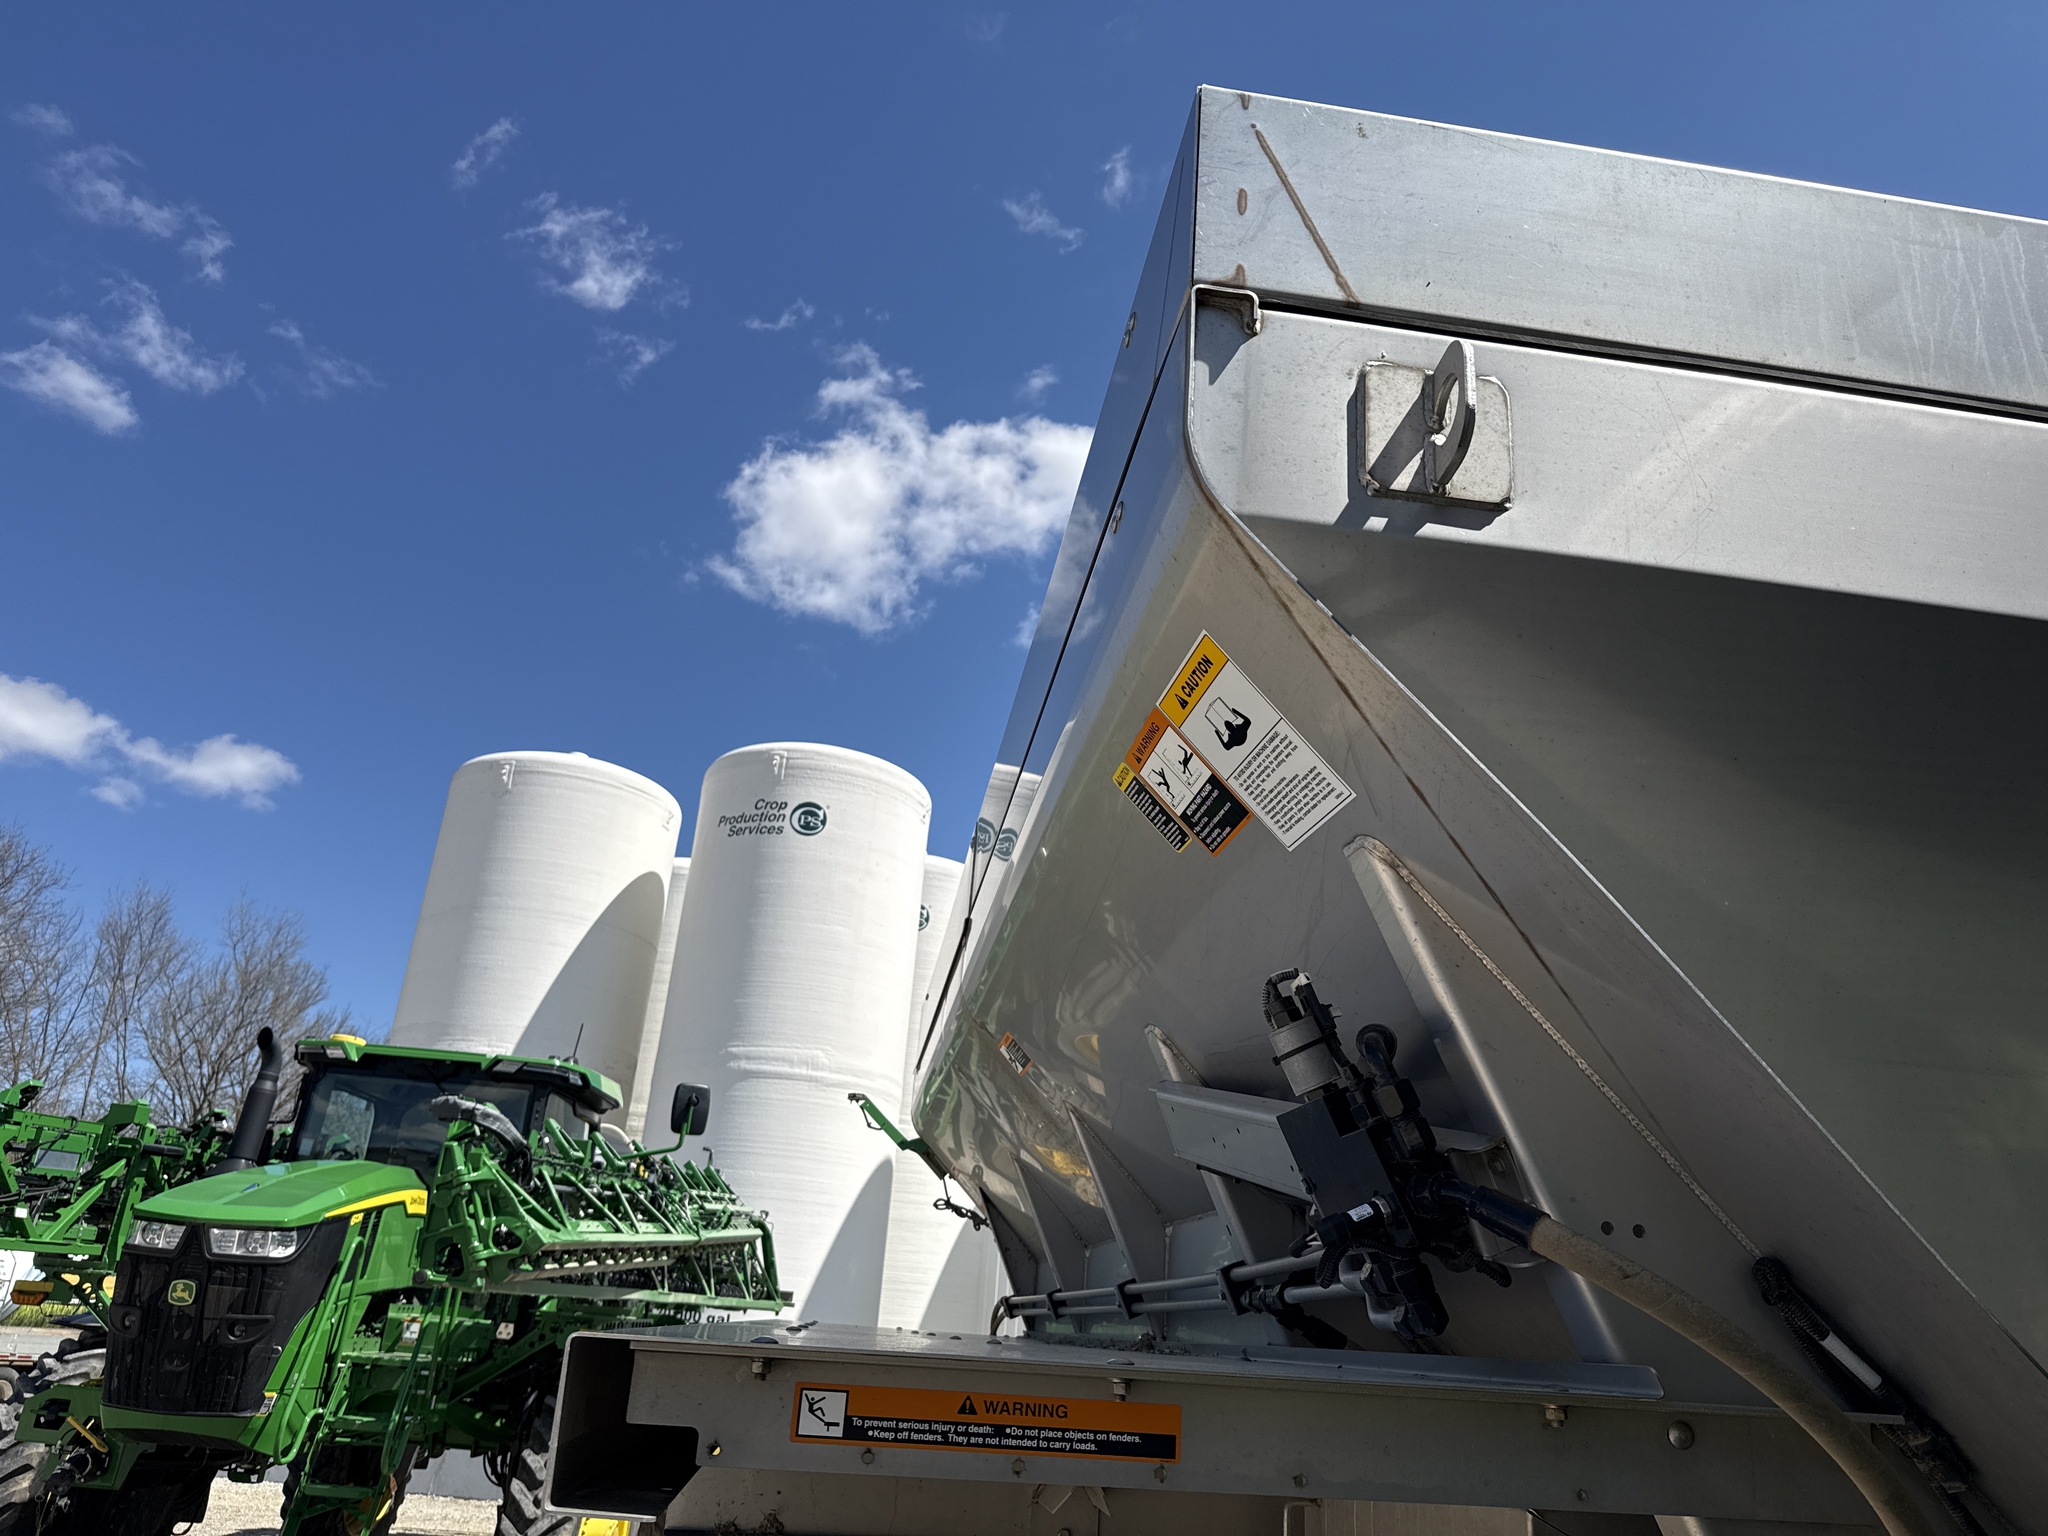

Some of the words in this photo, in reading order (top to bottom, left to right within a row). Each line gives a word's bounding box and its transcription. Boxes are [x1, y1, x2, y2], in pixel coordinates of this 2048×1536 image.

[1181, 654, 1214, 697] CAUTION
[1136, 721, 1160, 756] WARNING
[755, 799, 788, 812] Crop
[718, 811, 786, 827] Production
[728, 823, 784, 837] Services
[706, 1313, 730, 1323] gal
[984, 1399, 1068, 1419] WARNING
[852, 1417, 862, 1426] To
[864, 1419, 896, 1429] prevent
[898, 1421, 929, 1430] serious
[931, 1422, 955, 1432] injury
[968, 1424, 994, 1433] death:
[873, 1430, 895, 1440] Keep
[897, 1431, 909, 1439] off
[910, 1432, 944, 1441] fenders.
[948, 1434, 968, 1444] They
[985, 1436, 999, 1445] not
[1001, 1438, 1037, 1447] intended
[1039, 1440, 1048, 1448] to
[1050, 1442, 1071, 1451] carry
[1073, 1442, 1098, 1451] loads.
[1011, 1427, 1023, 1436] Do
[1040, 1429, 1062, 1439] place
[1064, 1431, 1094, 1440] objects
[1109, 1432, 1142, 1443] fenders.
